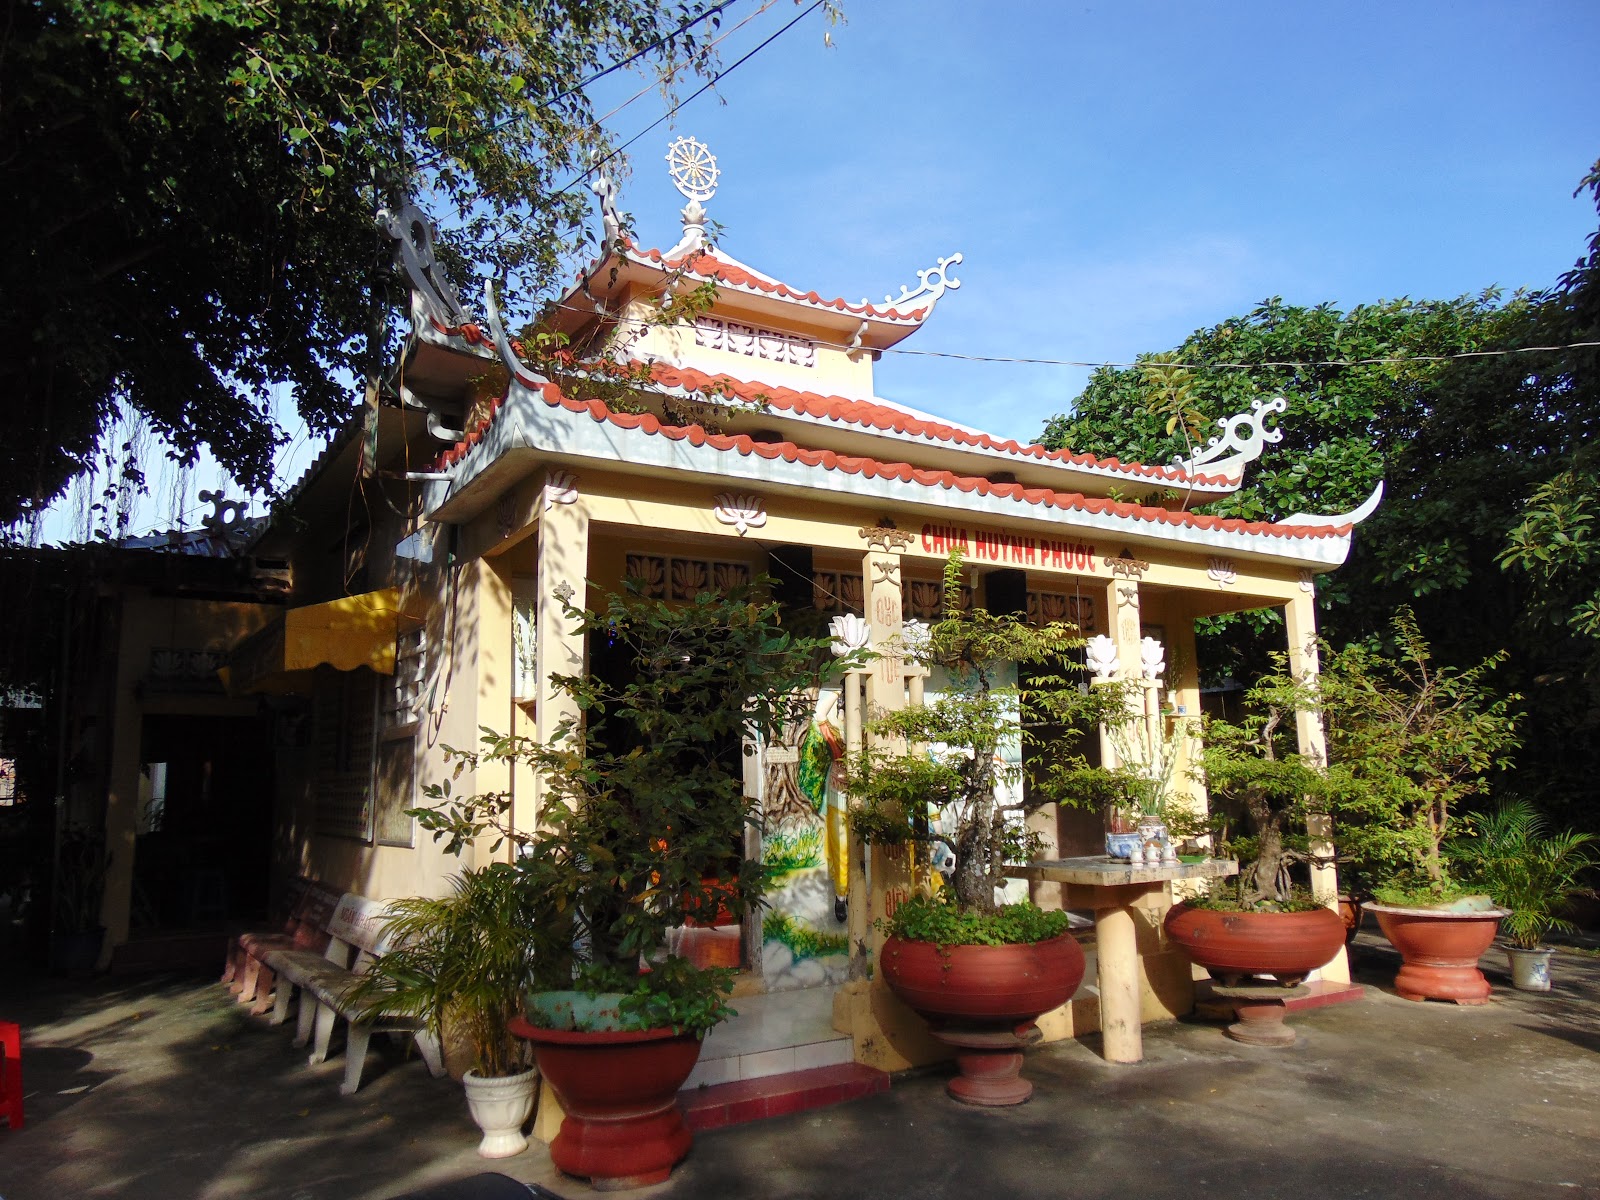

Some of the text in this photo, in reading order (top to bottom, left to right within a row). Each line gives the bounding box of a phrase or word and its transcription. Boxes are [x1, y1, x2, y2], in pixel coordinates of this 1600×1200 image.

[921, 521, 1096, 573] CHÙA HUỲNH PHƯỚC
